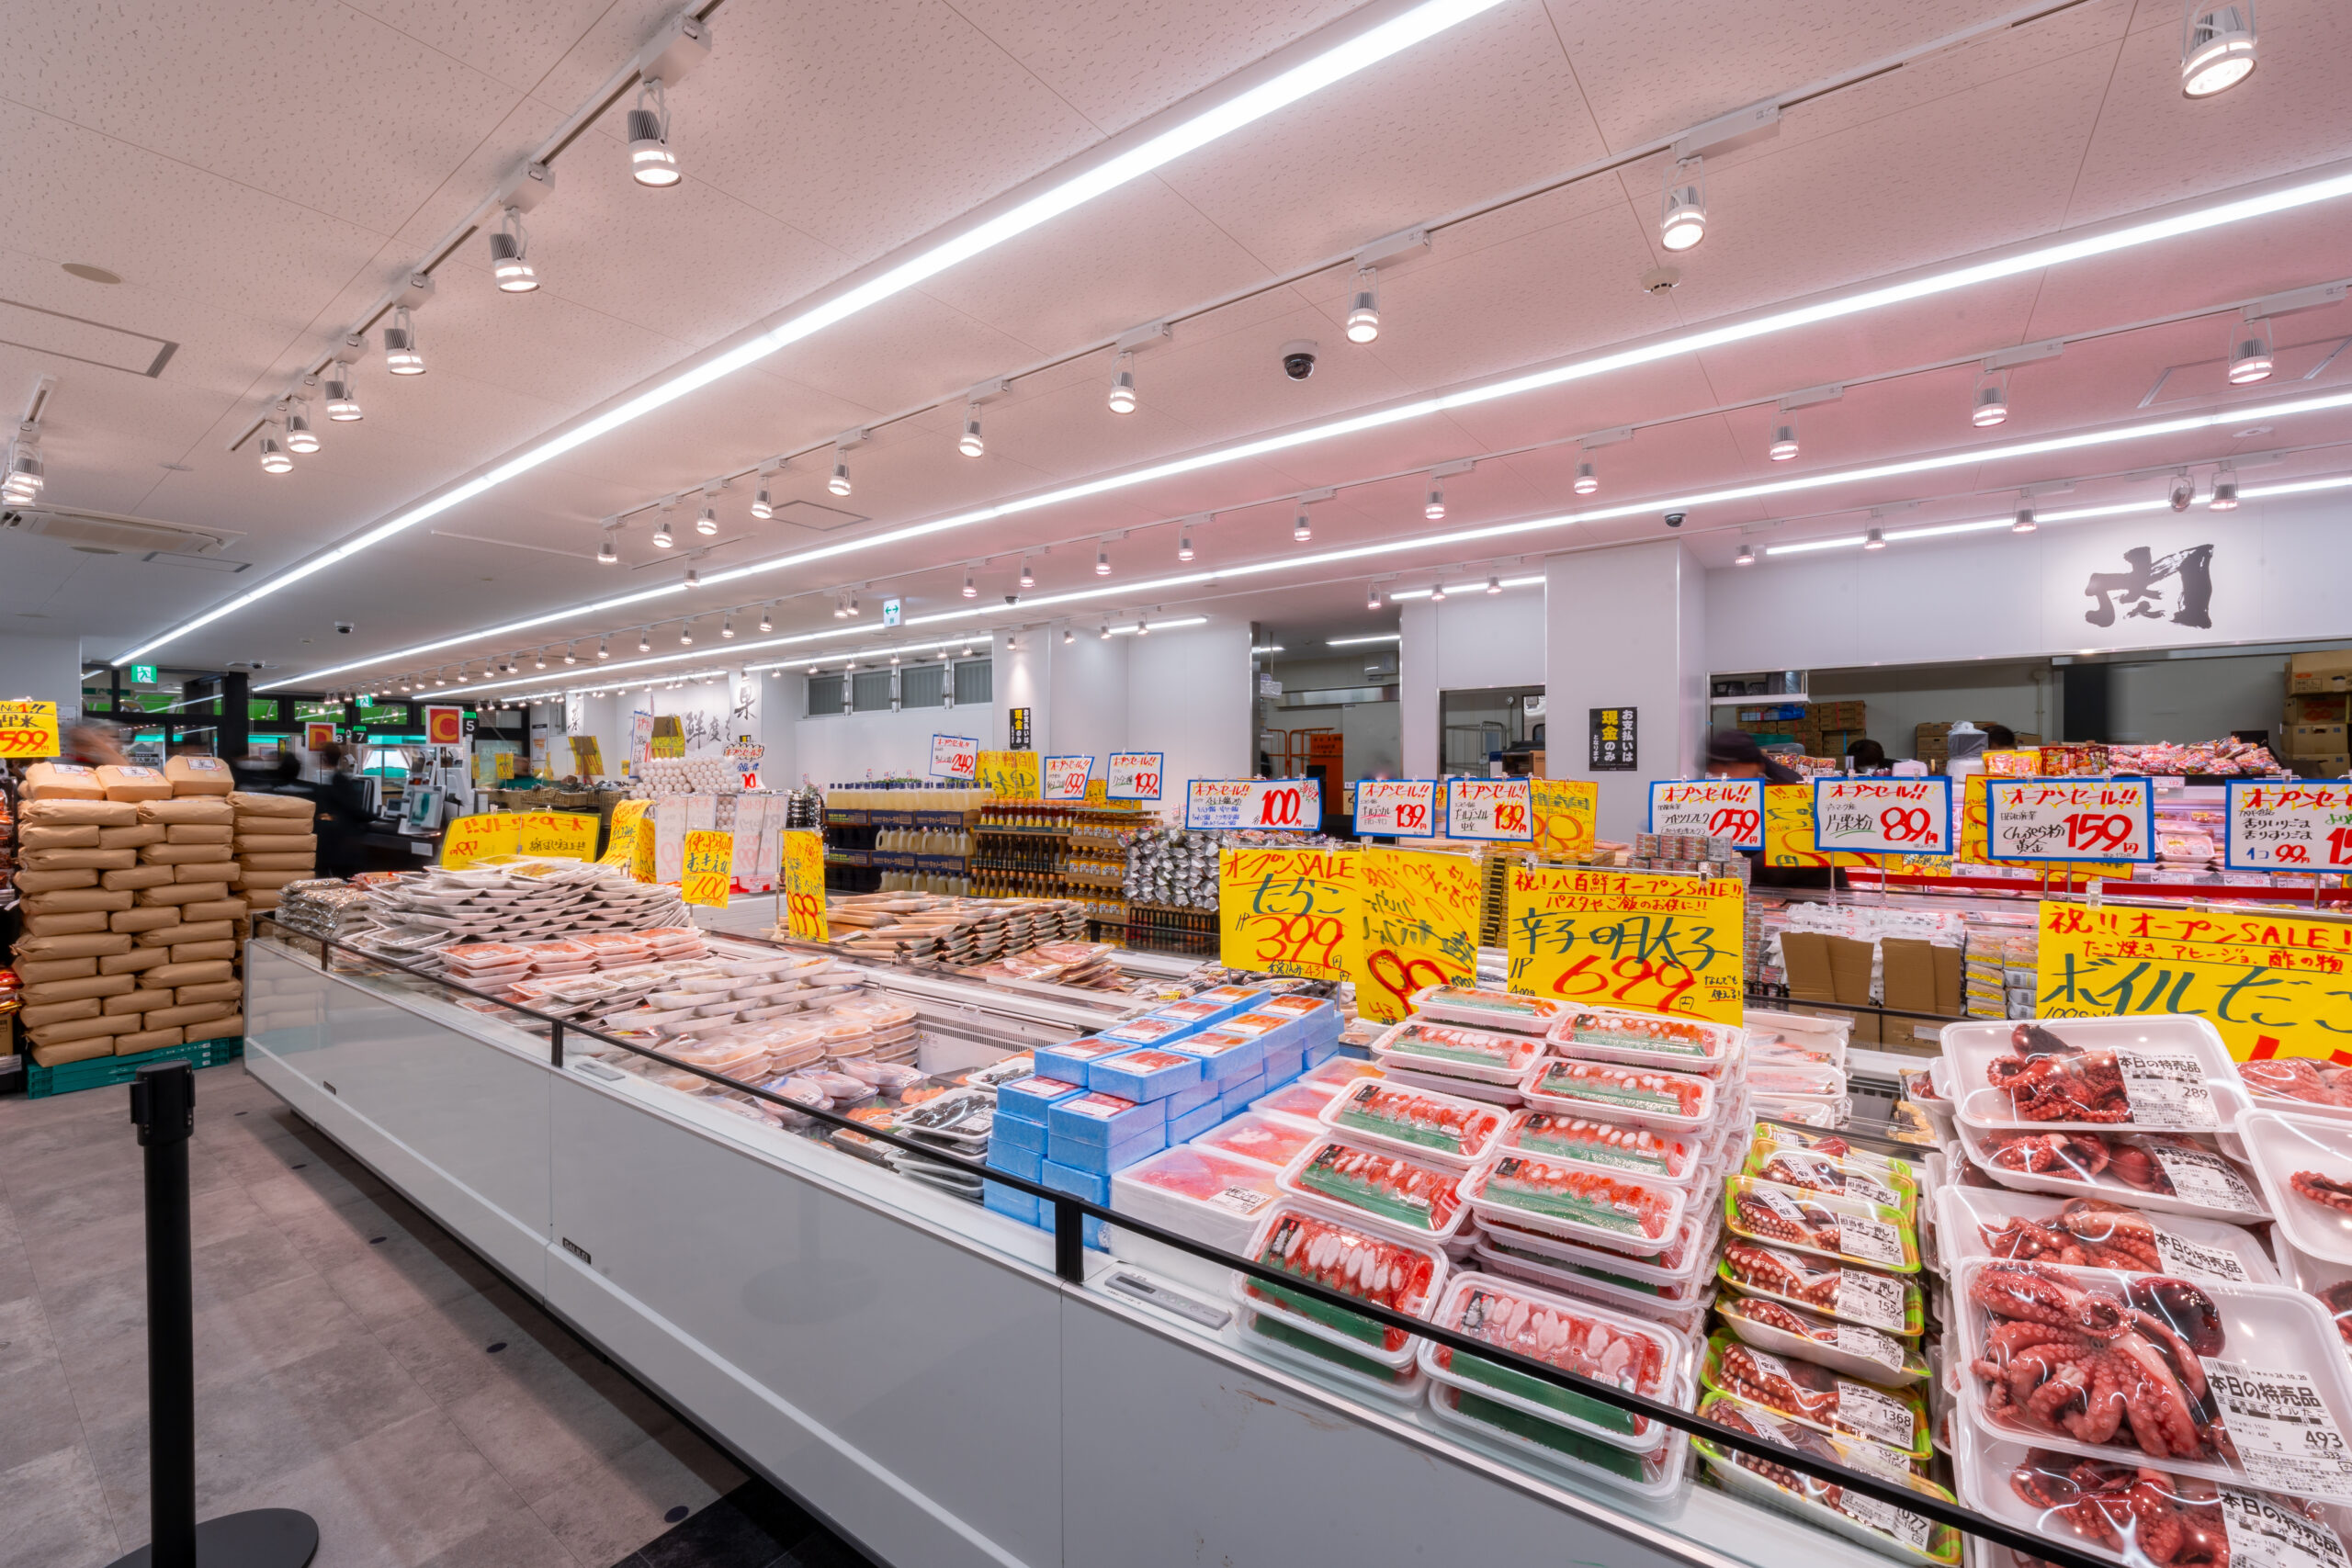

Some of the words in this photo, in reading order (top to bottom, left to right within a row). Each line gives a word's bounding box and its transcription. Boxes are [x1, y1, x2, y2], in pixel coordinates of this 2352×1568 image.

[2085, 544, 2214, 629] 肉
[734, 684, 757, 720] 果
[432, 714, 458, 740] C
[466, 721, 475, 732] 5
[1602, 710, 1618, 761] 現金のみ
[1622, 710, 1634, 761] お支払いは
[310, 728, 333, 749] D
[357, 733, 365, 741] 7
[1363, 784, 1430, 797] オープンセール!!
[1457, 782, 1526, 800] オープンセール!!
[1665, 784, 1752, 803] オープンセール!!
[1830, 784, 1928, 800] オープンセール!!
[2007, 788, 2138, 806] オープンセール!!
[1826, 814, 1873, 831] 片栗粉
[1223, 852, 1355, 879] オープンSALE
[1250, 874, 1345, 917] たらこ
[1512, 908, 1738, 971] 辛子明太子
[1704, 975, 1738, 986] なんでも
[2119, 1055, 2201, 1074] 本日の特売品
[2183, 1087, 2208, 1100] 289
[1882, 1244, 1900, 1253] 562
[2156, 1233, 2243, 1274] 本日の特売品
[1878, 1300, 1902, 1316] 1552
[2207, 1372, 2322, 1407] 本日の特売品
[1883, 1409, 1911, 1427] 1368
[2305, 1430, 2344, 1449] 493
[2220, 1493, 2343, 1557] 本日の特売品
